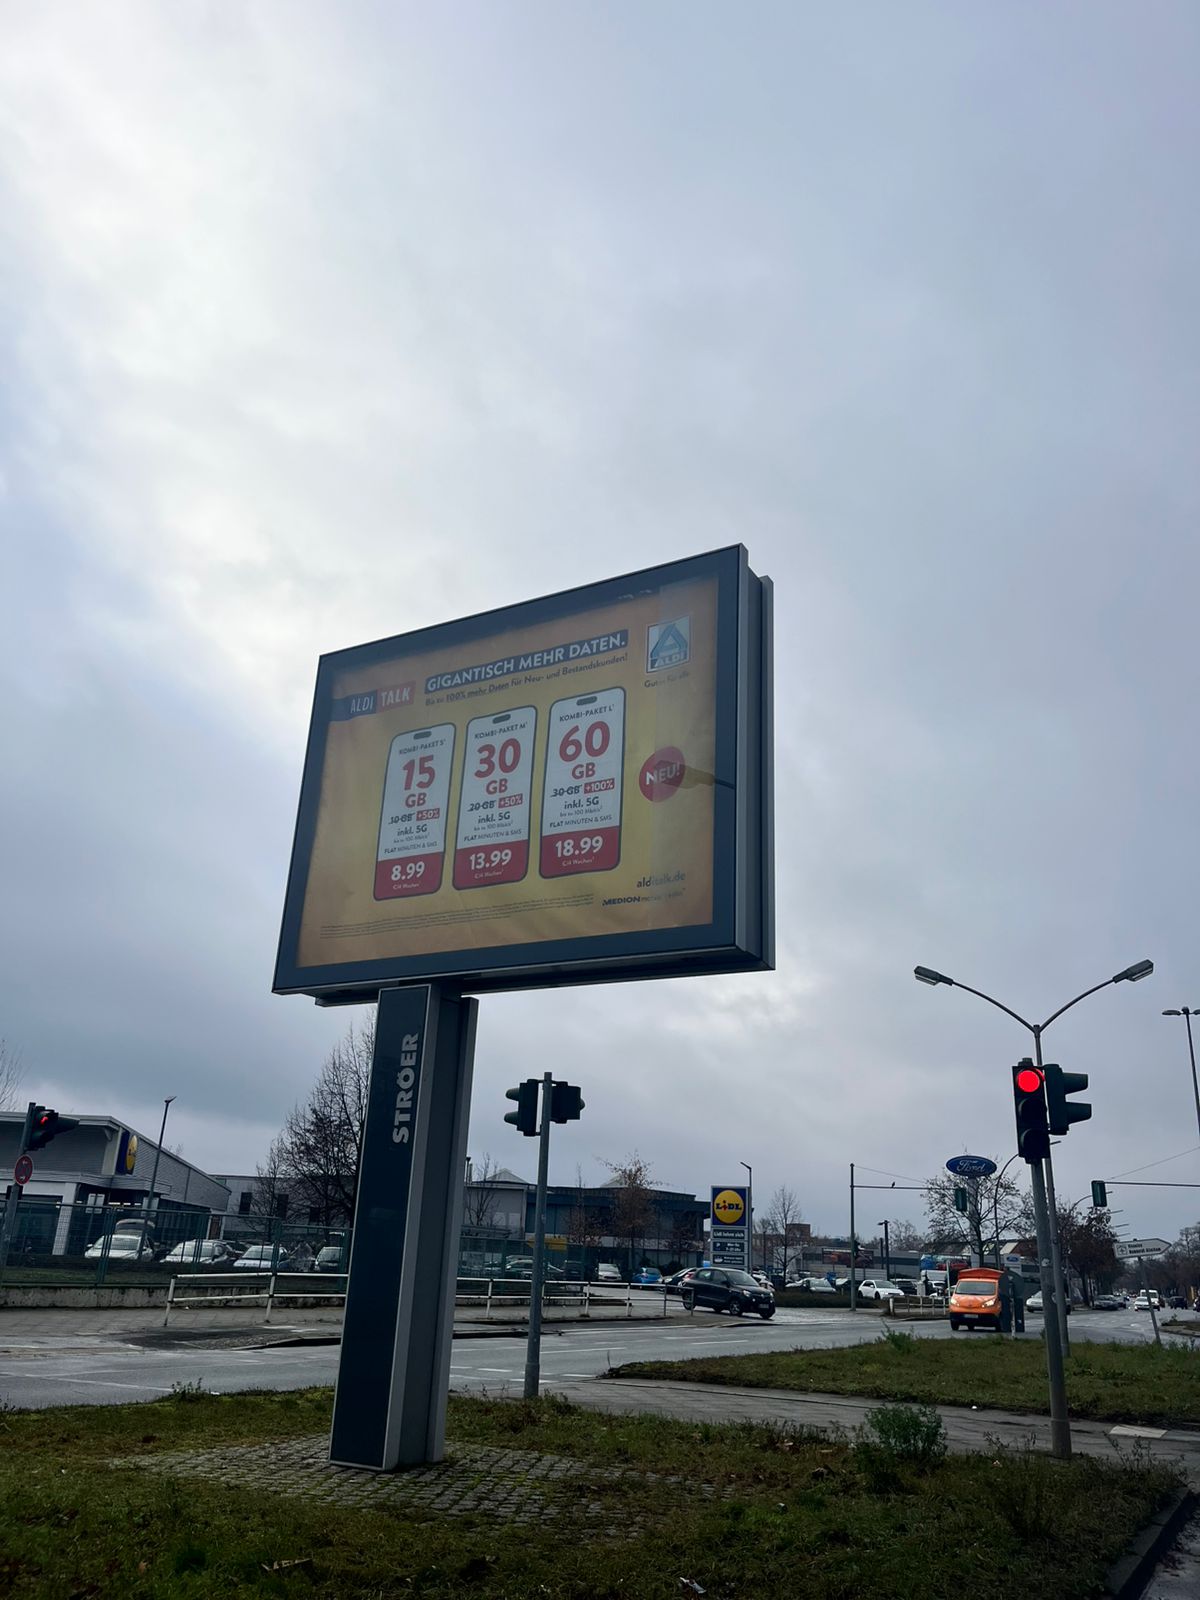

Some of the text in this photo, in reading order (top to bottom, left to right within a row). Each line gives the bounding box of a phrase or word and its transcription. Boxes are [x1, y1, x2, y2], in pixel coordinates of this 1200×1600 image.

[427, 634, 626, 691] GIGANTISCH MEHR DATEN.
[654, 651, 686, 668] ALDI
[446, 690, 466, 702] 100%
[467, 687, 487, 698] mehr
[488, 681, 509, 692] Daten
[511, 678, 523, 688] für
[524, 674, 544, 684] Neu-
[546, 668, 560, 679] und
[562, 652, 628, 675] Bestandskunden!
[350, 695, 374, 714] ALDI
[381, 686, 411, 707] TALK
[559, 706, 607, 722] KOMBI-PAKET
[474, 724, 518, 739] KOMBI-PAKET
[399, 740, 438, 754] KOMBI-PAKET
[559, 721, 610, 762] 60
[474, 738, 521, 778] 30
[403, 754, 436, 791] 15
[571, 762, 596, 780] GB
[646, 762, 680, 785] NEU!
[486, 778, 508, 795] GB
[566, 785, 580, 795] GB
[586, 779, 614, 792] +100%
[405, 792, 427, 808] GB
[499, 795, 522, 807] +50%
[564, 796, 599, 809] inkl. 5G
[417, 809, 439, 820] +50%
[478, 811, 511, 824] inkl. 5G
[550, 820, 563, 828] FLAT
[564, 817, 593, 826] MINUTEN
[416, 824, 427, 833] 5G
[478, 831, 504, 839] MINUTEN
[555, 835, 603, 858] 18.99
[469, 849, 512, 870] 13.99
[391, 861, 425, 881] 8.99
[602, 896, 640, 906] MEDION
[392, 1032, 419, 1143] STRÖER
[956, 1160, 986, 1172] Ford
